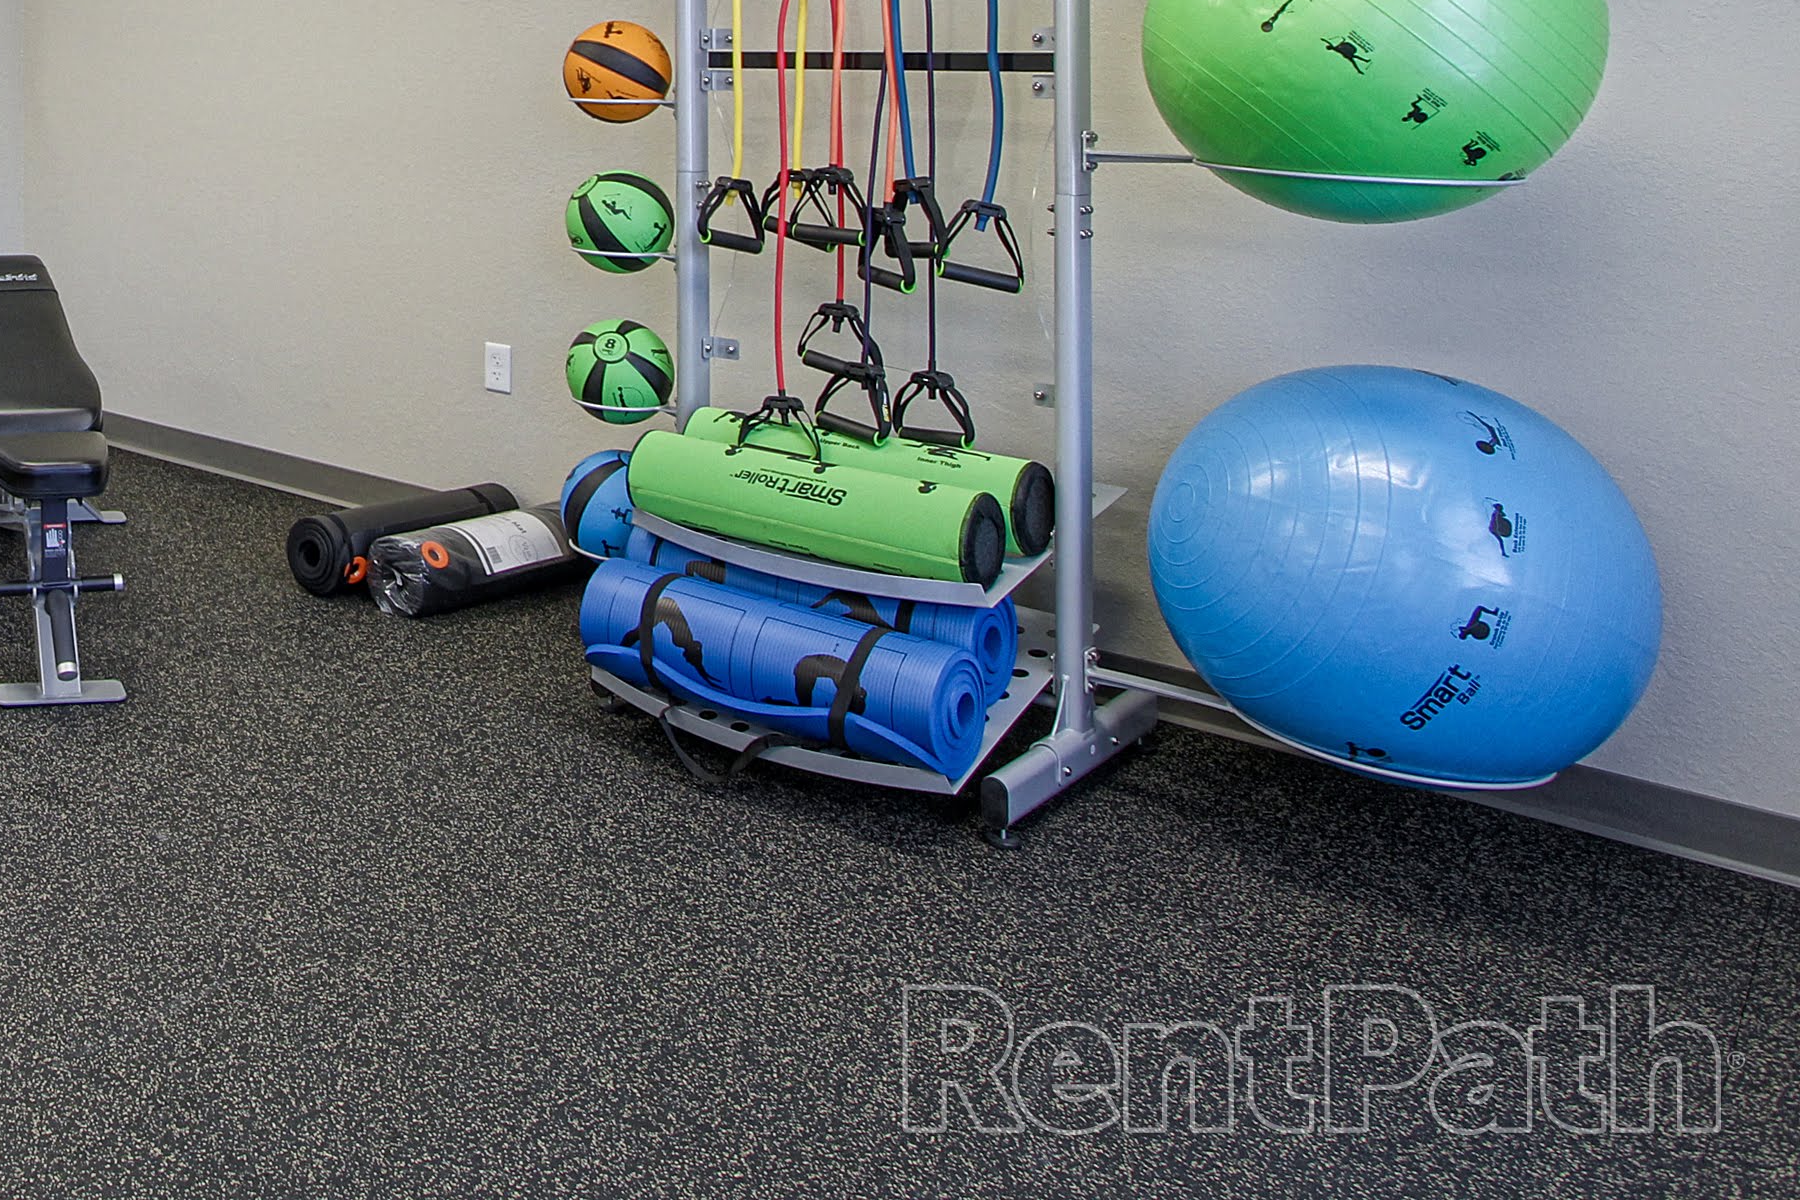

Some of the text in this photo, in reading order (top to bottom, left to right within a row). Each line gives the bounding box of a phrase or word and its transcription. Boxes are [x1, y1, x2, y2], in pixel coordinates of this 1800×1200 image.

[604, 338, 617, 349] 8
[1400, 664, 1472, 730] Smart
[1457, 679, 1481, 705] Ball
